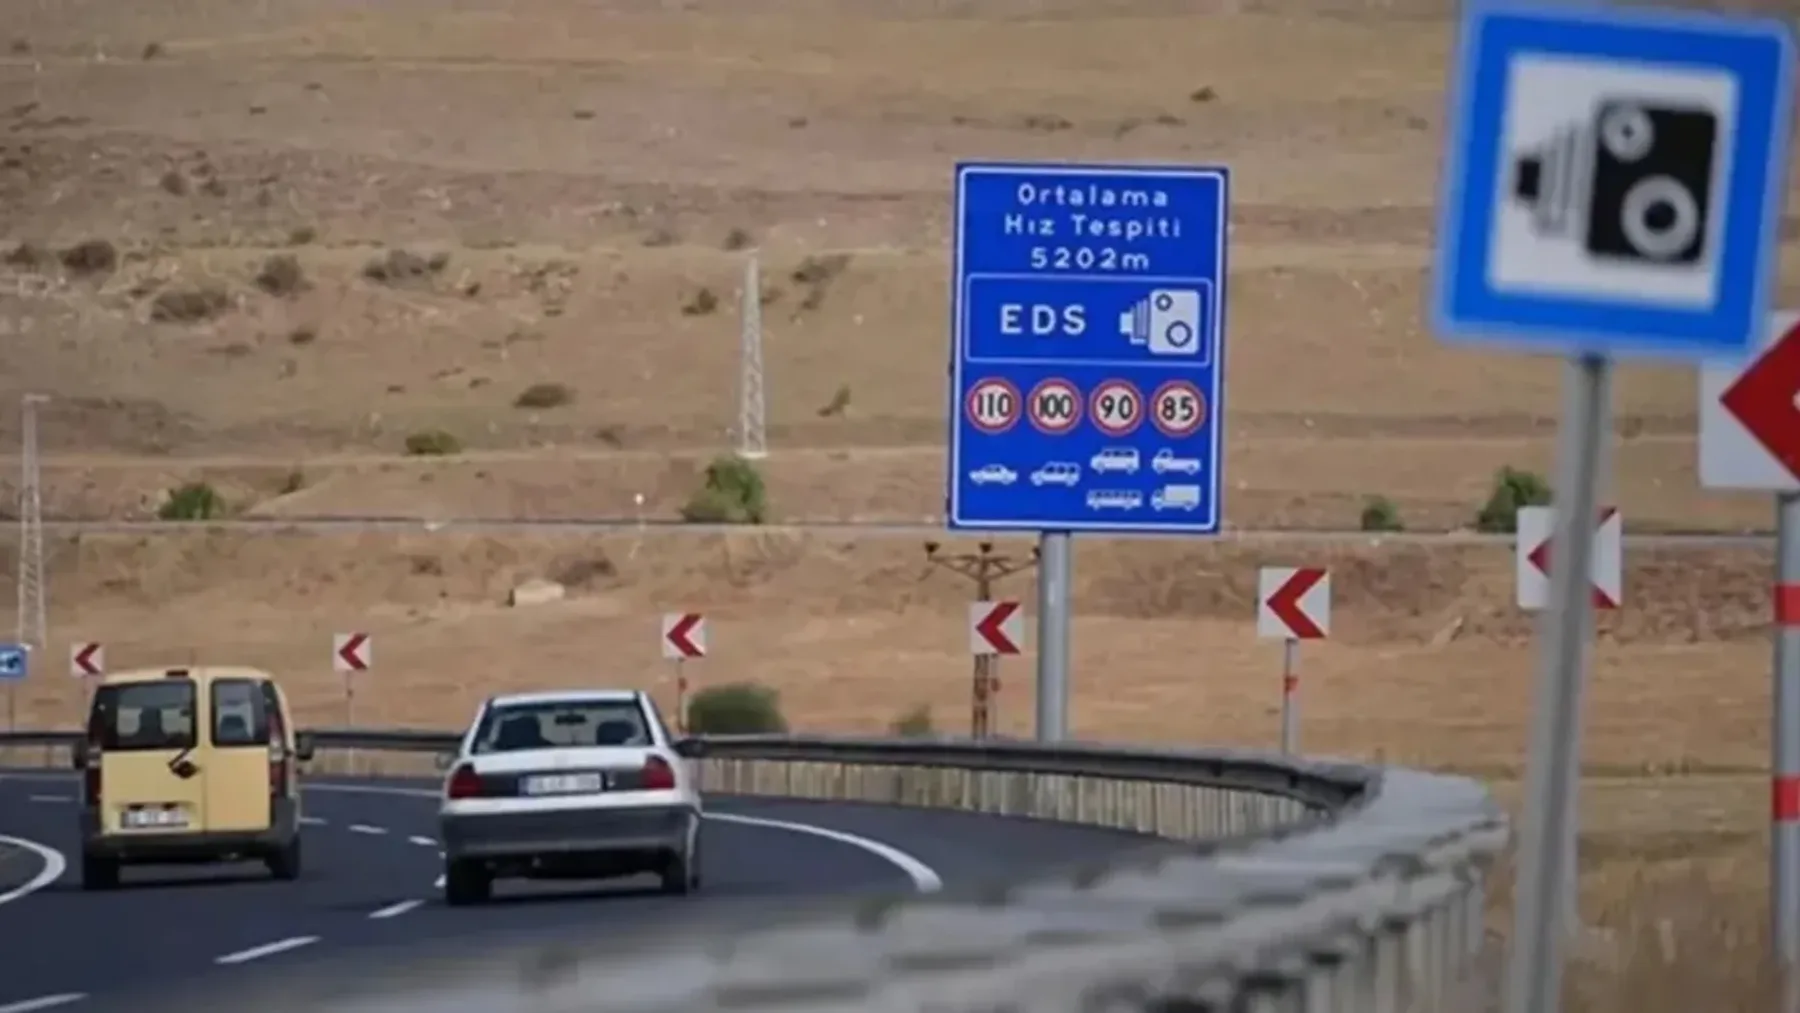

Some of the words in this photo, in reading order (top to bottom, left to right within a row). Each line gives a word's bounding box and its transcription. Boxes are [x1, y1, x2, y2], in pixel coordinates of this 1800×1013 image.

[1017, 182, 1168, 206] Ortalama
[1004, 213, 1055, 235] Hız
[1071, 214, 1181, 241] Tespiti
[1031, 246, 1149, 269] 5202m
[1000, 303, 1087, 335] EDS
[976, 392, 1012, 418] 110
[1038, 393, 1073, 419] 100
[1100, 395, 1135, 420] 90
[1161, 396, 1195, 421] 85
